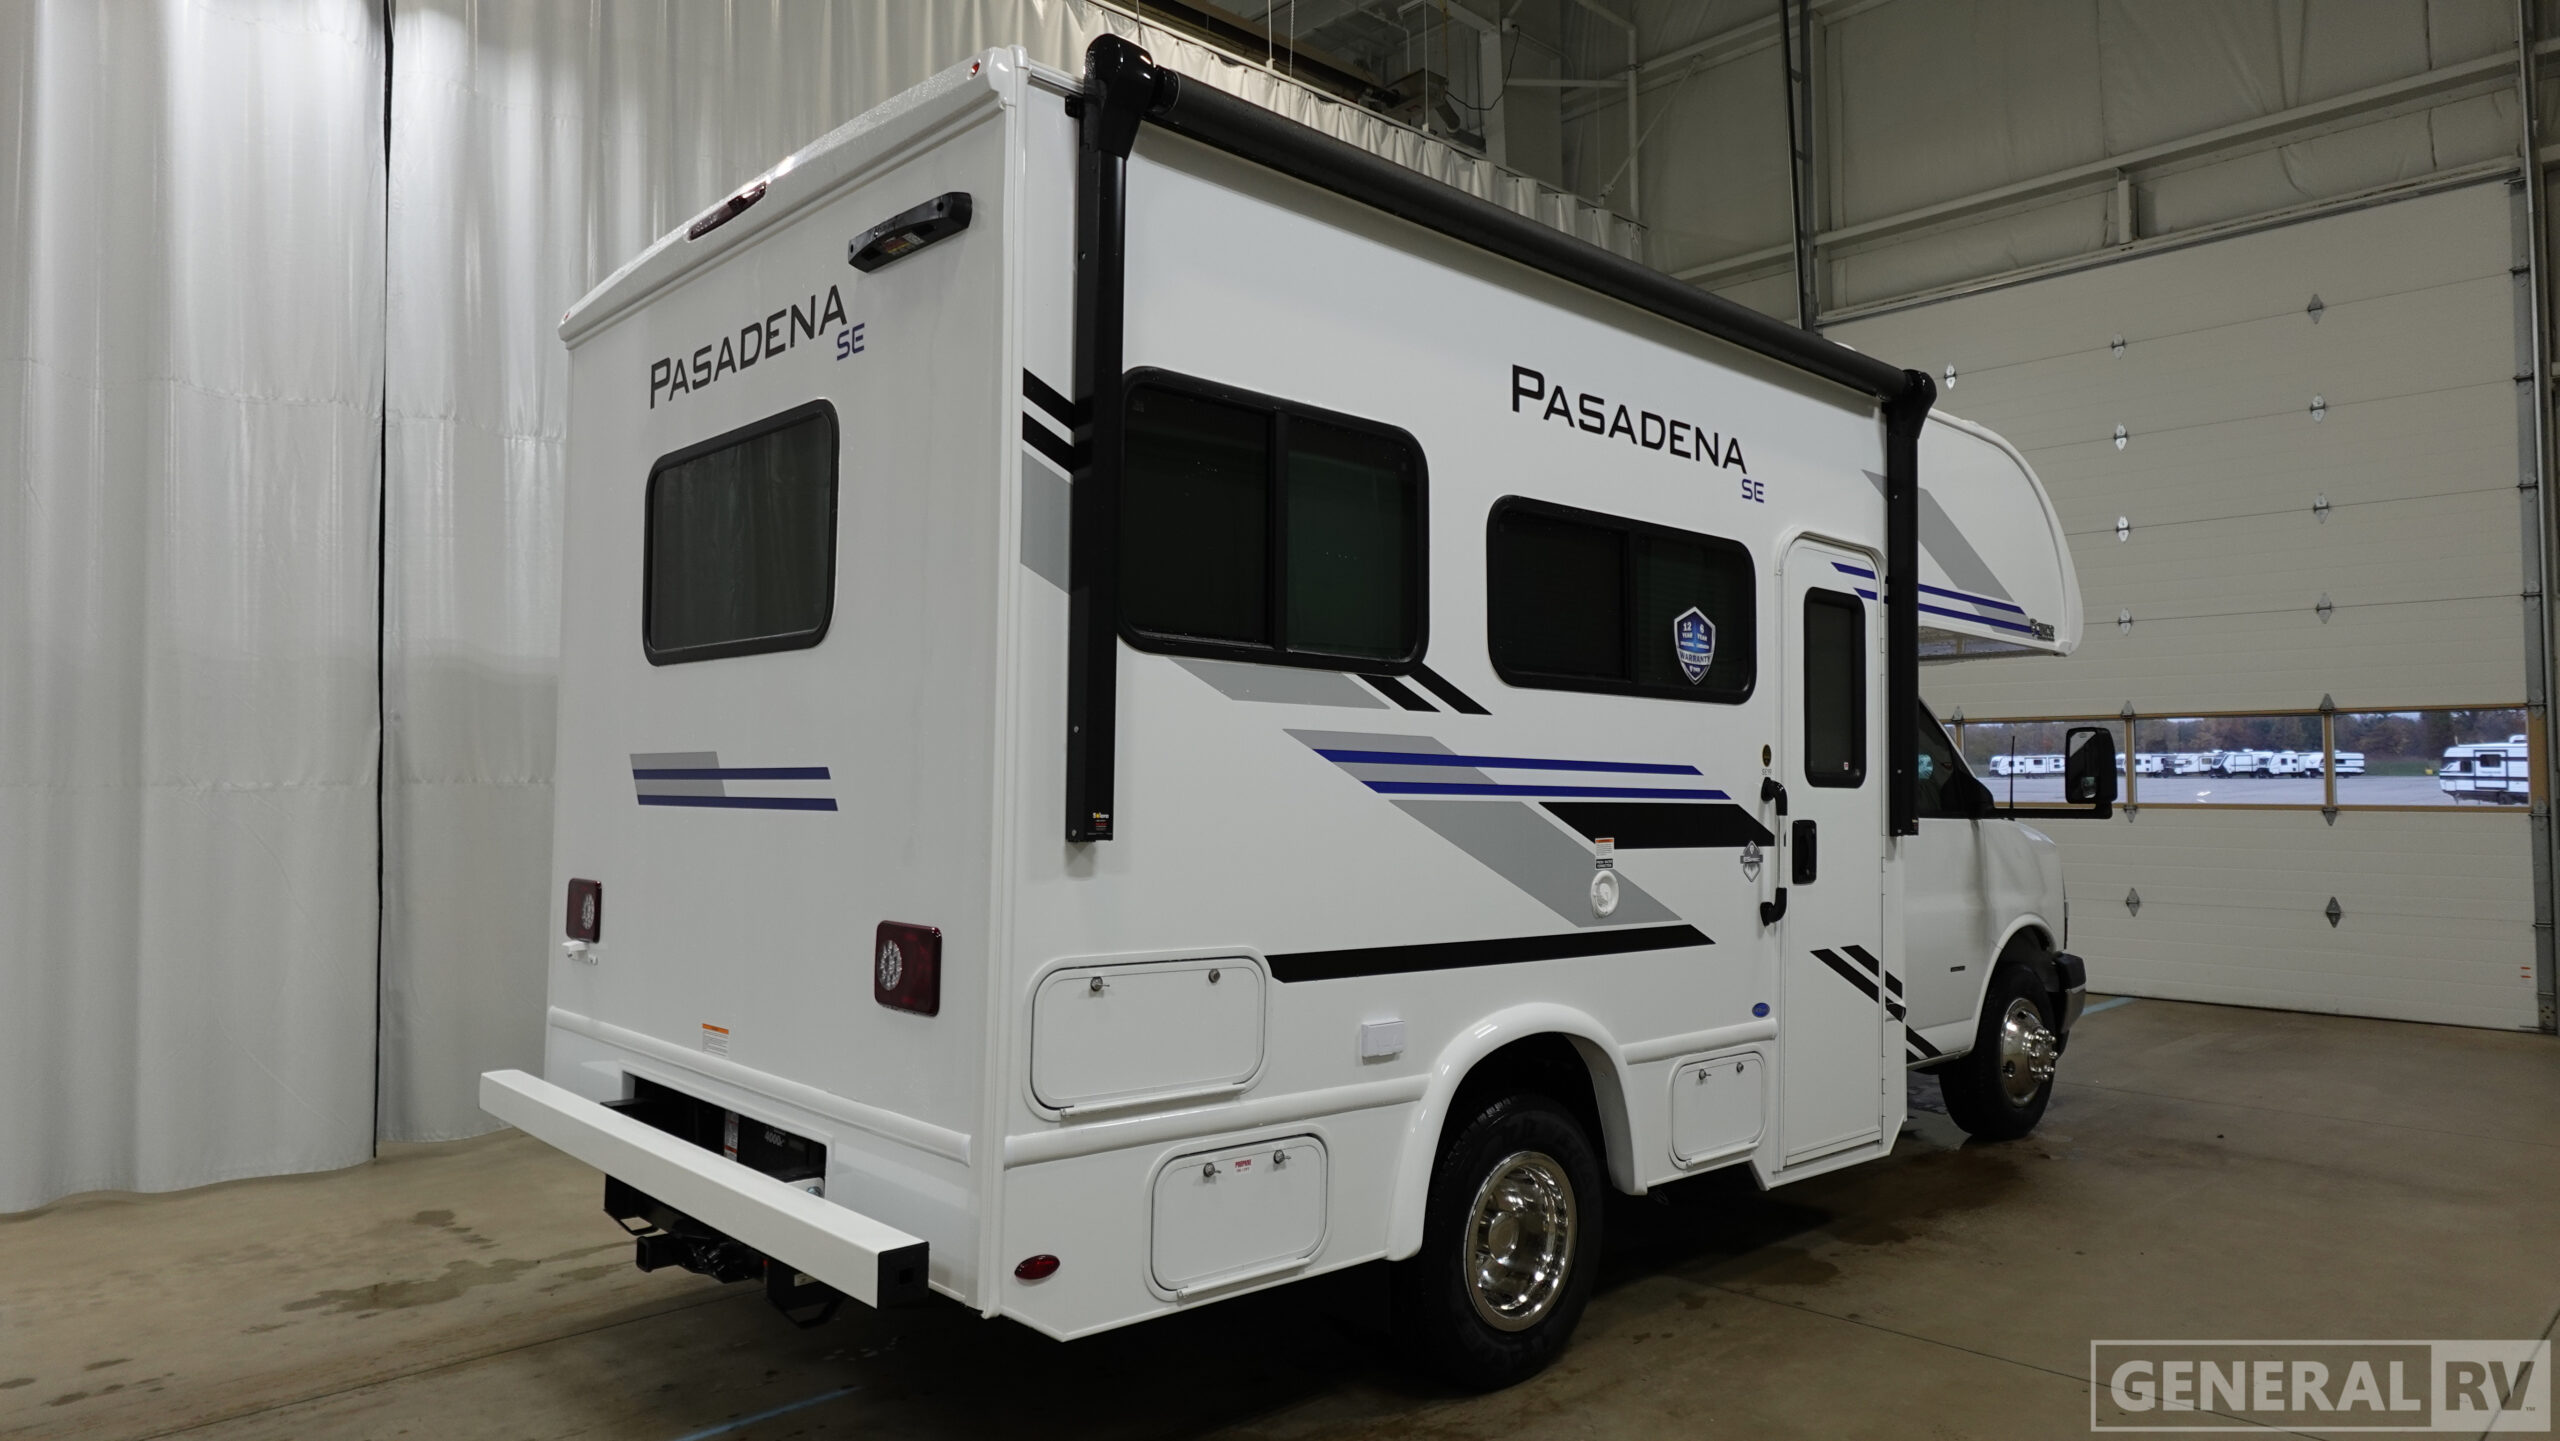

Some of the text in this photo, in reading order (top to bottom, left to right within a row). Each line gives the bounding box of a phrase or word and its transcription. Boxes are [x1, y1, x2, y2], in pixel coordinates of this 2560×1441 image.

[650, 284, 848, 410] PASADENA
[836, 322, 866, 361] SE
[1512, 364, 1748, 475] PASADENA
[1741, 478, 1765, 504] SE
[1683, 621, 1692, 631] 12
[1699, 624, 1705, 634] 6
[1697, 633, 1708, 642] YEAR
[1680, 652, 1711, 663] WARRANTY
